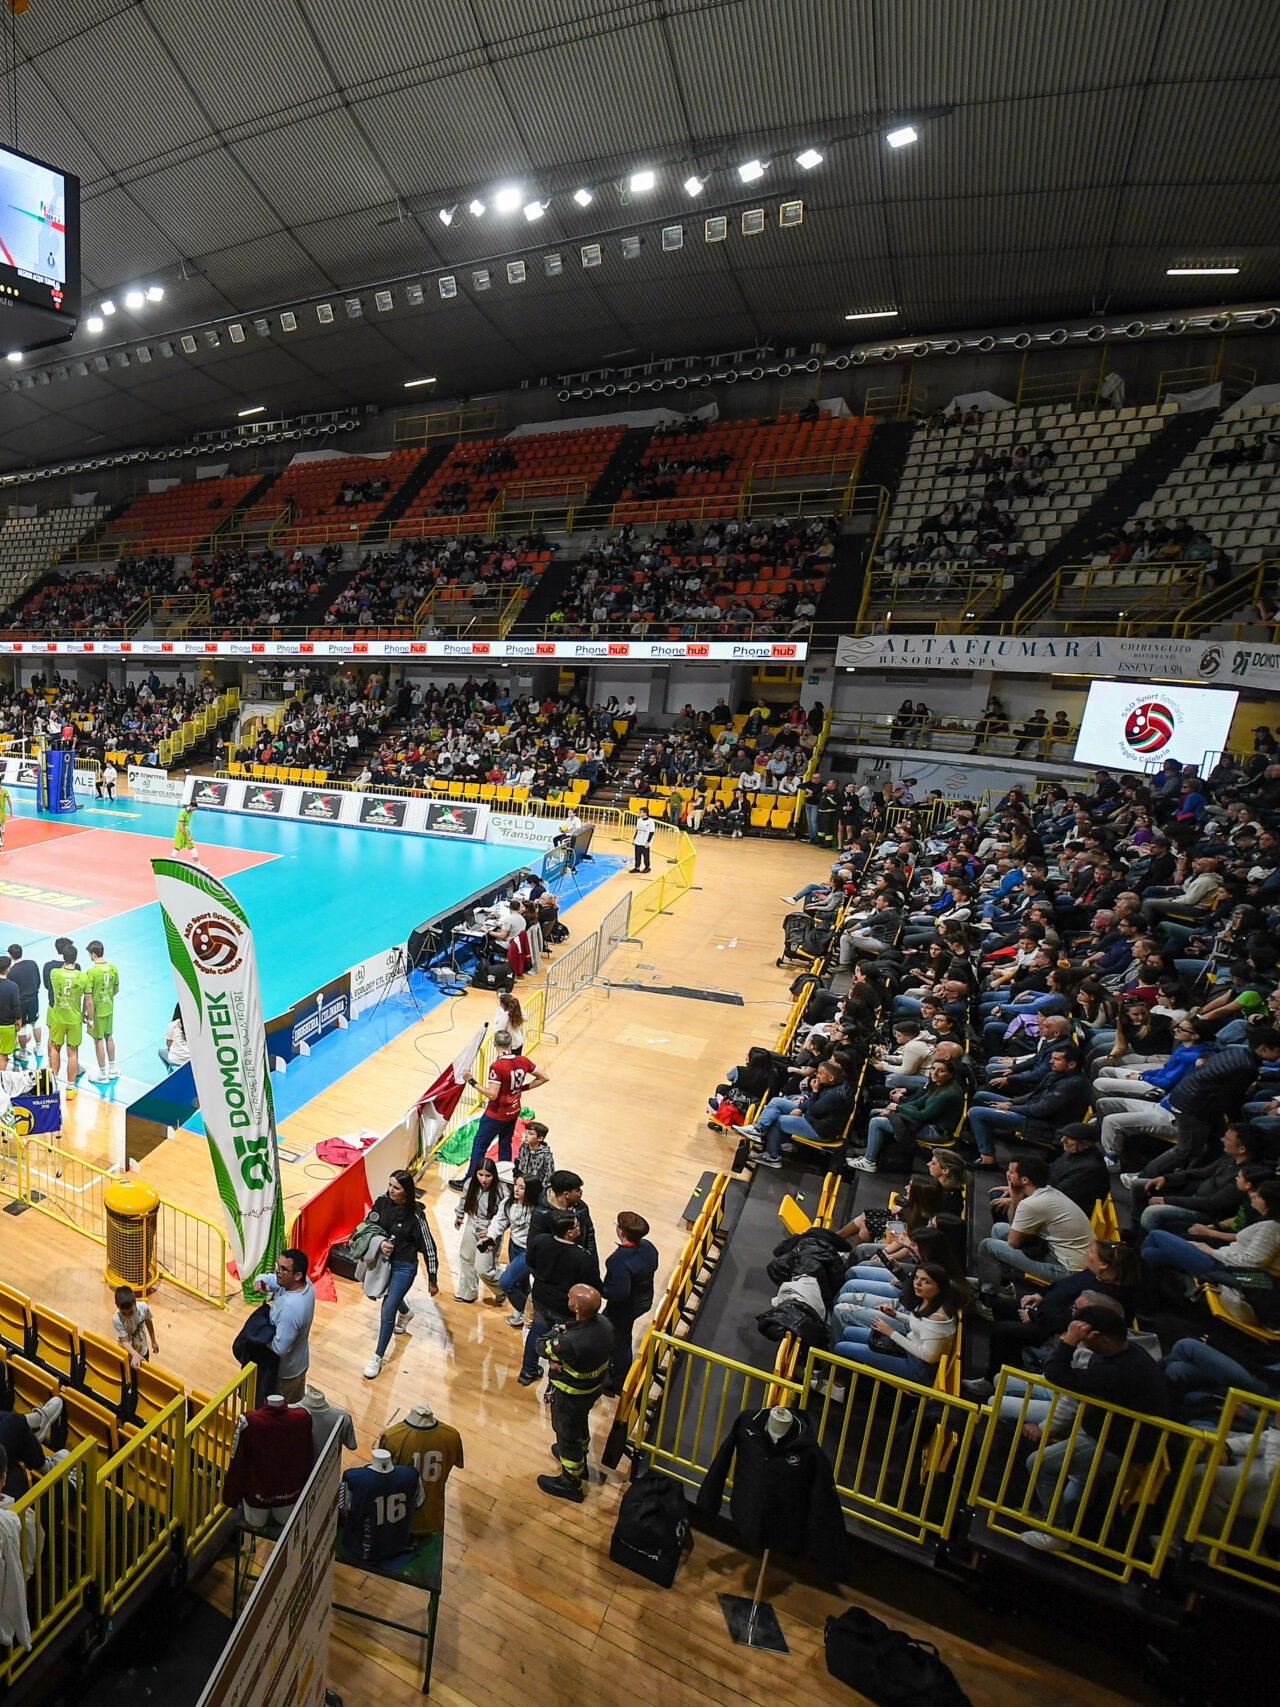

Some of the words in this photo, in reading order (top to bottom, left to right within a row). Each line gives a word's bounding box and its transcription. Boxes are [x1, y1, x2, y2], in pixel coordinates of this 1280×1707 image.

[881, 638, 1102, 657] ALTAFIUMARA
[1120, 644, 1191, 654] CHIRINGUITO
[879, 655, 945, 665] RESORT
[950, 657, 959, 666] &
[968, 657, 996, 667] SPA
[1118, 662, 1168, 673] ESSENTA
[1136, 693, 1158, 704] Sport
[1160, 694, 1184, 724] Specialist
[1118, 741, 1138, 761] Reggio
[1139, 748, 1170, 762] Calabria
[498, 827, 554, 843] Transport
[184, 922, 194, 939] ASD
[192, 912, 211, 924] Sport
[213, 912, 243, 936] Specialist
[193, 959, 216, 974] Reggio
[218, 957, 243, 974] Calabria
[64, 978, 72, 995] 2
[354, 981, 375, 997] ECOLOGY
[375, 975, 385, 986] CTL
[204, 990, 251, 1128] DOMOTEK
[244, 1057, 256, 1080] PER
[510, 1069, 525, 1090] 13
[412, 1449, 443, 1482] 16
[374, 1492, 406, 1526] 16
